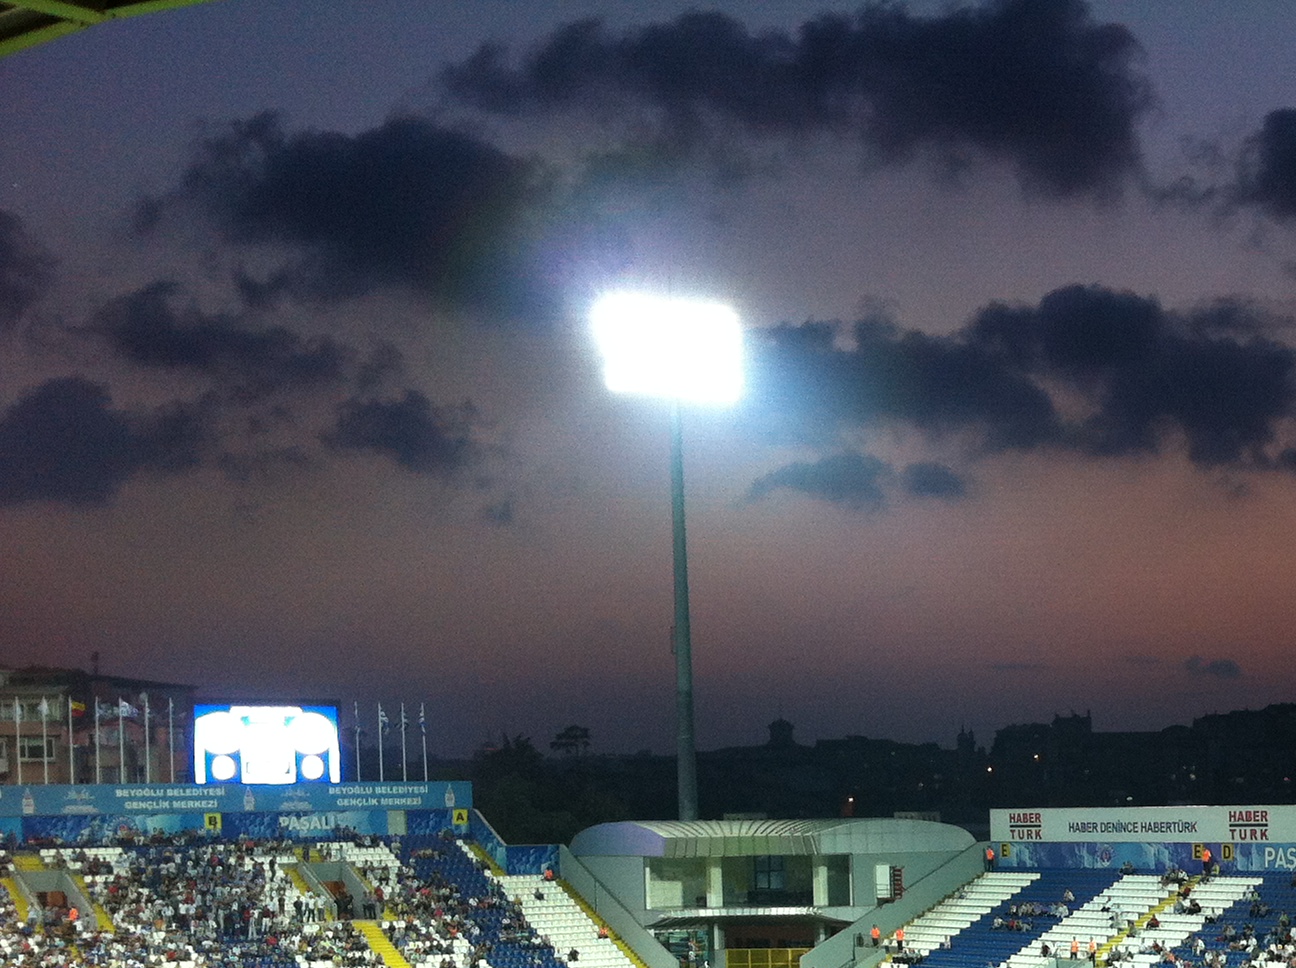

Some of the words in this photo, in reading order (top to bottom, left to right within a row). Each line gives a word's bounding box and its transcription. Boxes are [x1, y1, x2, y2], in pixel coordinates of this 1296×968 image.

[1009, 813, 1041, 823] HABER
[1229, 811, 1268, 822] HABER
[1069, 821, 1099, 833] HABER
[1140, 820, 1198, 833] HABERTÜRK
[1011, 829, 1042, 840] TURK
[1230, 829, 1269, 840] TURK
